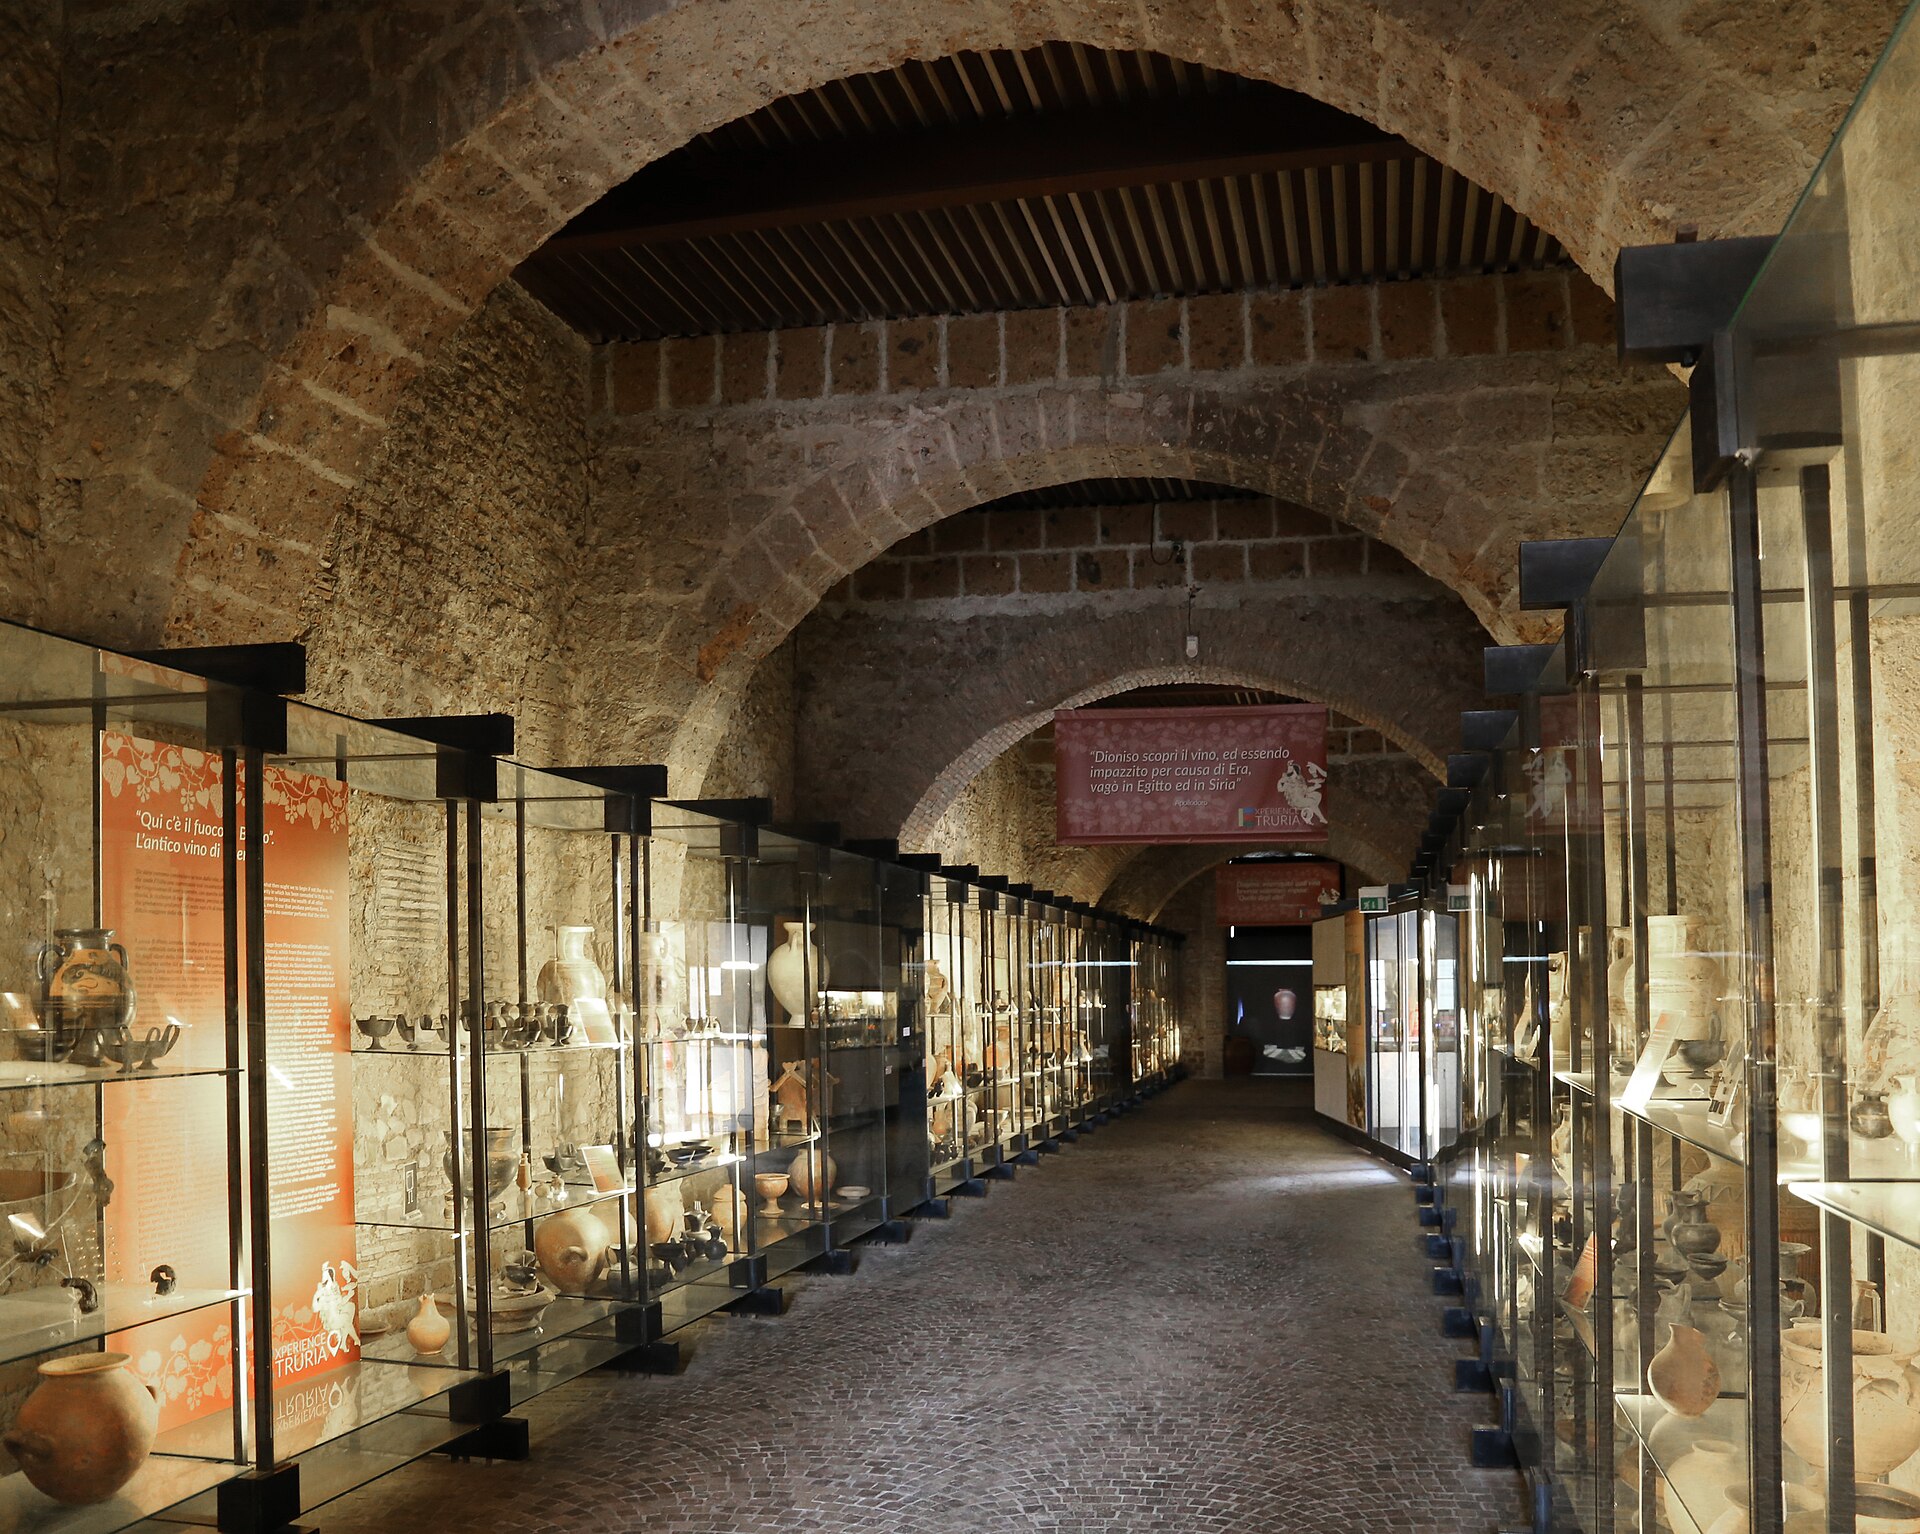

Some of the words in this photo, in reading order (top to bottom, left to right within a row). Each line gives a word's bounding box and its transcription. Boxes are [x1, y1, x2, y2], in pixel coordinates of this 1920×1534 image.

[1090, 750, 1139, 762] “Dioniso
[1142, 749, 1178, 763] scoprì
[1181, 748, 1188, 761] il
[1191, 749, 1219, 761] vino,
[1223, 747, 1238, 760] ed
[1241, 746, 1290, 760] essendo
[1090, 765, 1148, 780] impazzito
[1151, 767, 1172, 779] per
[1174, 766, 1210, 776] causa
[1213, 763, 1225, 775] di
[1228, 762, 1252, 776] Era,
[1090, 780, 1119, 795] vagò
[1122, 780, 1133, 792] in
[1137, 779, 1172, 795] Egitto
[1175, 779, 1191, 791] ed
[1194, 778, 1205, 791] in
[1209, 778, 1242, 791] Siria”
[136, 810, 163, 830] “Qui
[166, 816, 182, 832] c’è
[184, 818, 192, 833] il
[194, 820, 223, 838] fuoco
[136, 832, 181, 853] L’antico
[183, 840, 208, 856] vino
[209, 842, 220, 858] di
[275, 1346, 328, 1378] TRURIA
